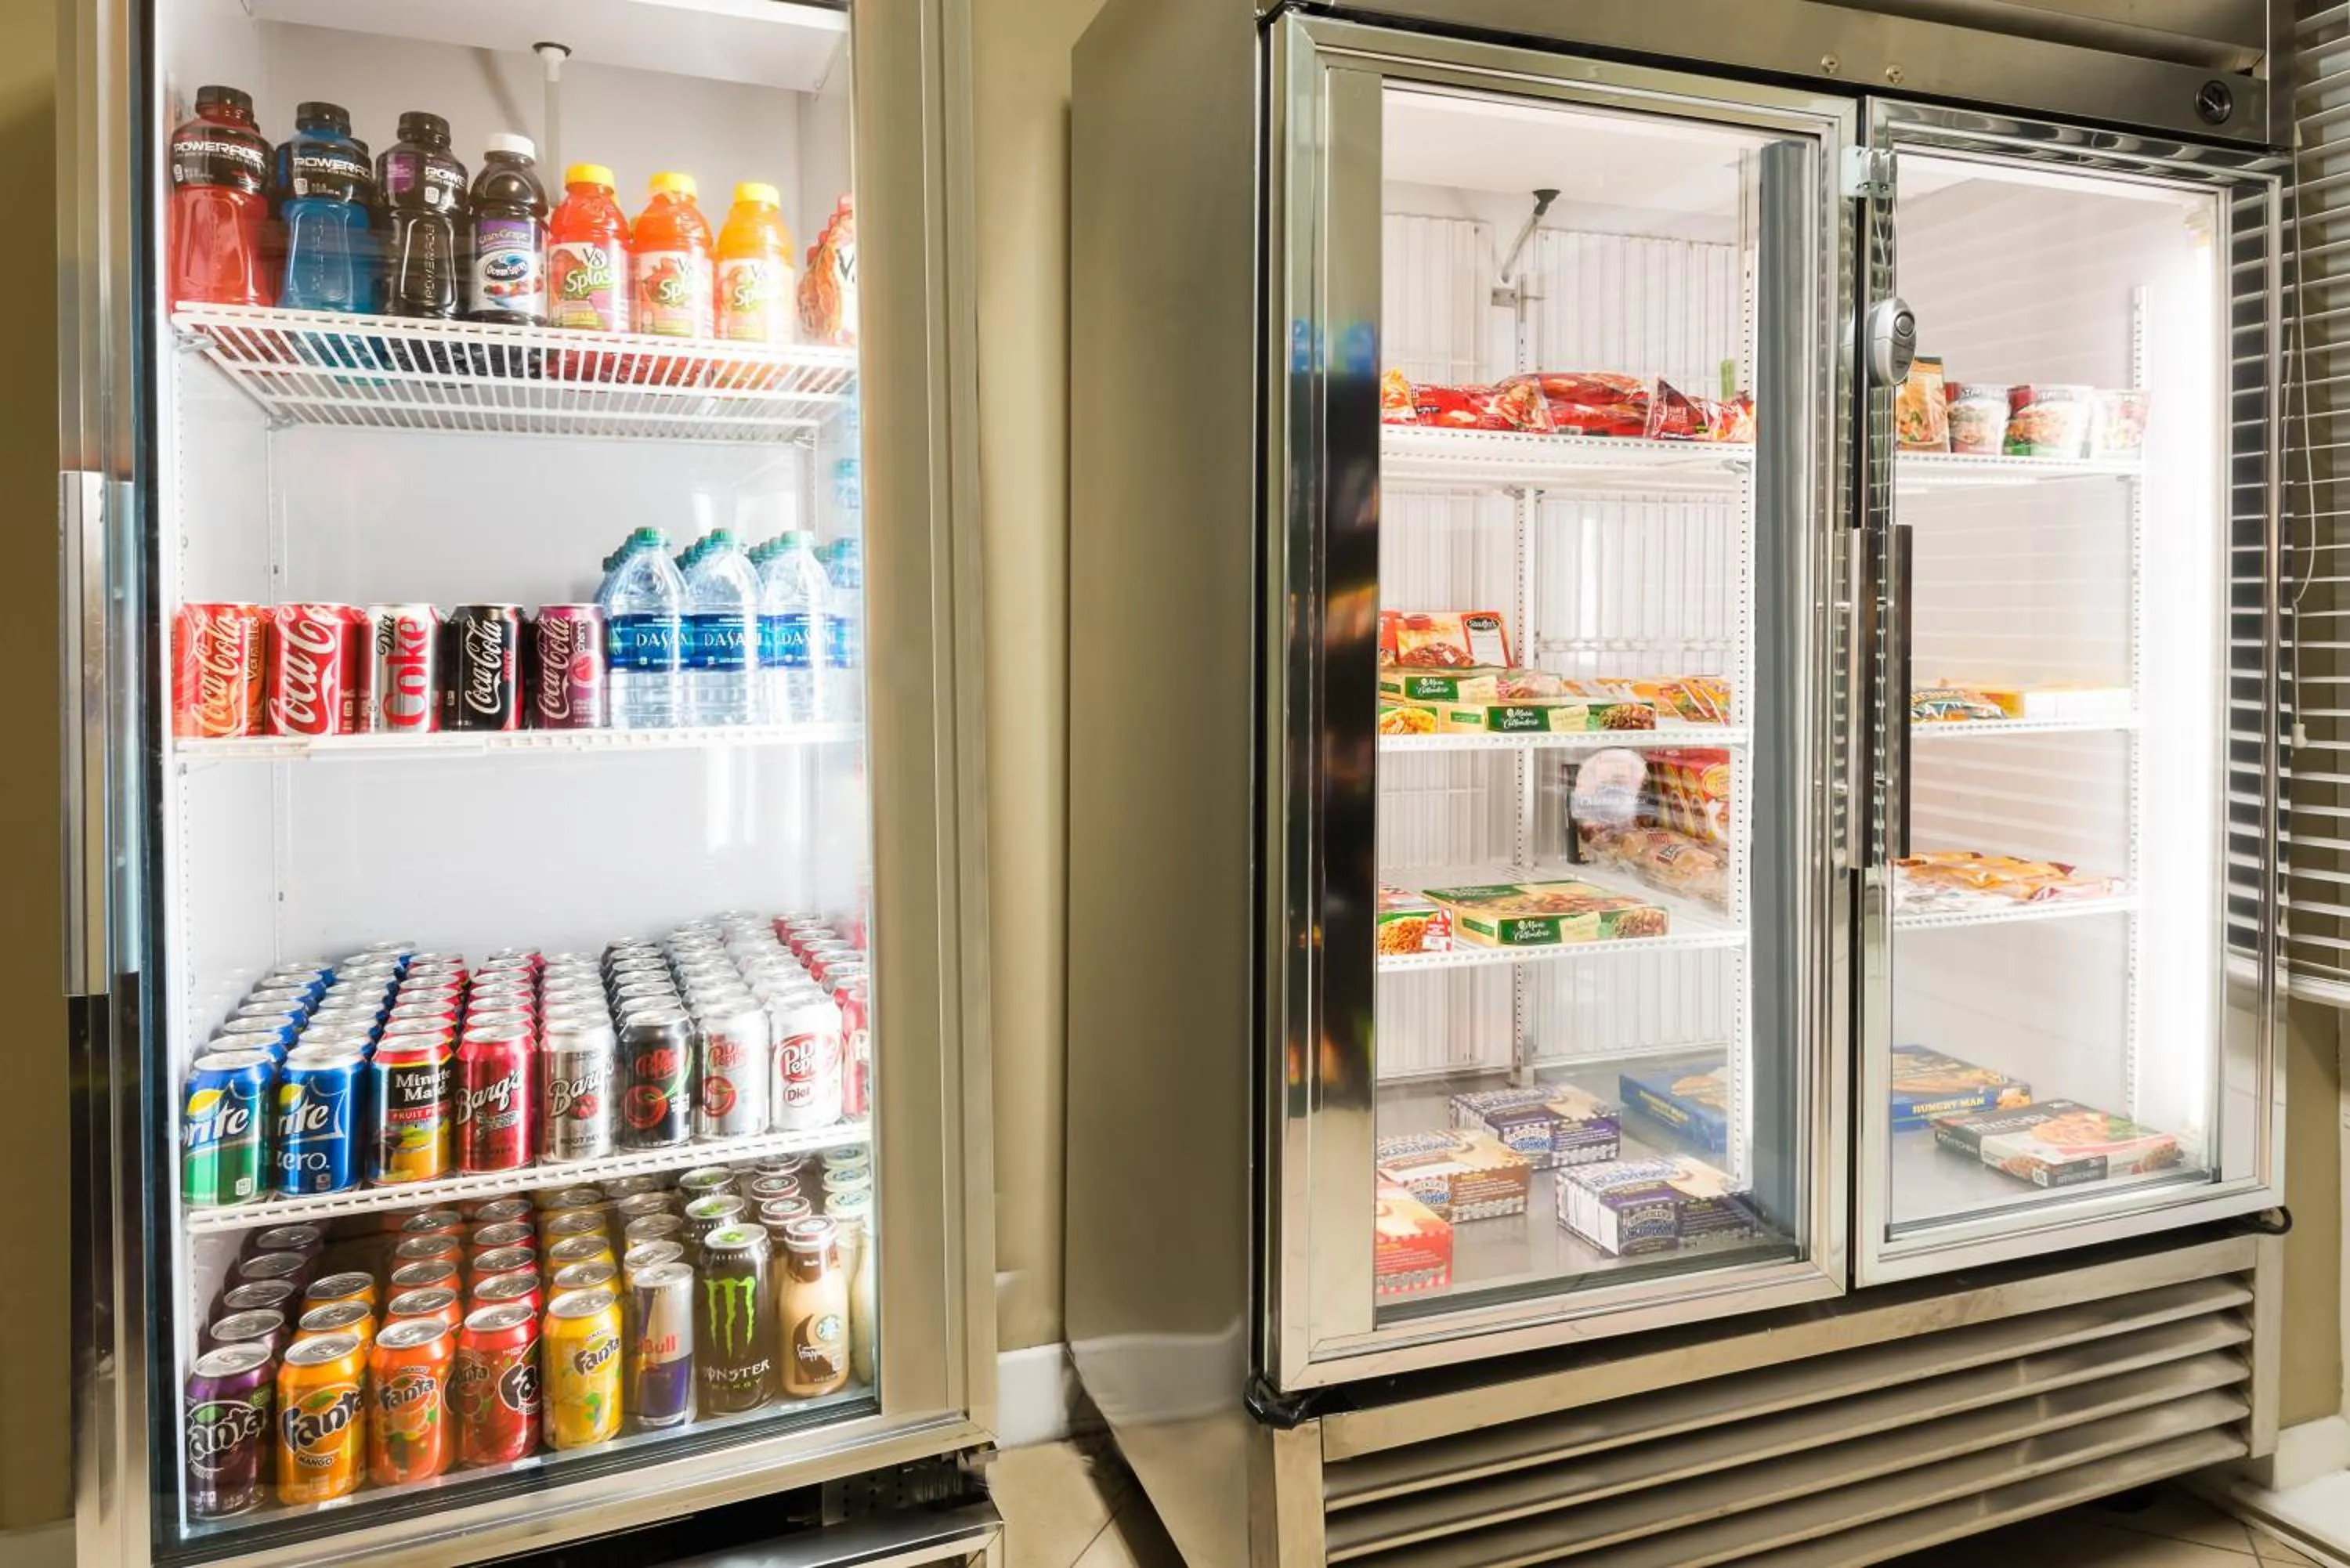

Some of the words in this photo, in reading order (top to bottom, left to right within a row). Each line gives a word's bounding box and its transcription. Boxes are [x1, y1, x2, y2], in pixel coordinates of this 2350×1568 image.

[173, 140, 264, 159] POWERADE
[582, 247, 608, 266] V8
[564, 266, 613, 295] Splas
[376, 613, 396, 656] Diet
[383, 615, 427, 727] Coke
[465, 614, 503, 714] Coca-Cola
[537, 615, 570, 720] Coca-Cola
[787, 1088, 812, 1102] Diet
[573, 1336, 621, 1376] Fanta
[707, 1358, 771, 1382] ONSTER
[378, 1375, 436, 1412] Fanta
[282, 1389, 364, 1454] Fanta
